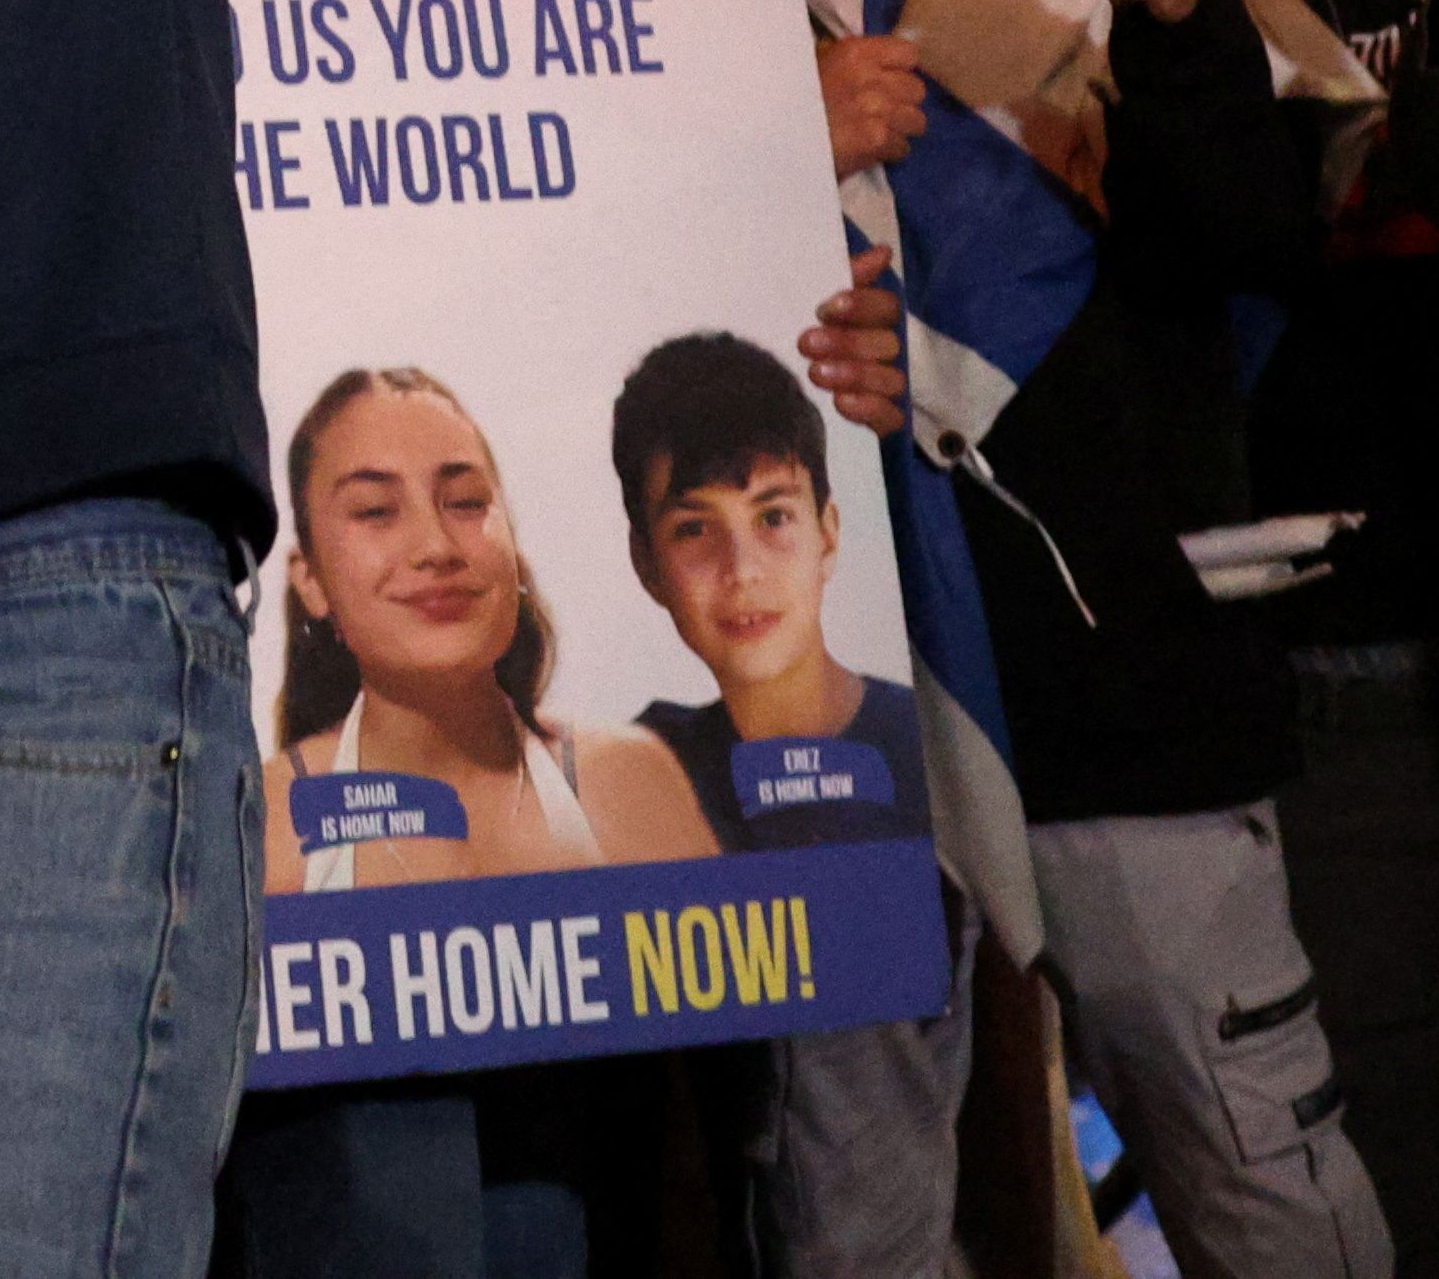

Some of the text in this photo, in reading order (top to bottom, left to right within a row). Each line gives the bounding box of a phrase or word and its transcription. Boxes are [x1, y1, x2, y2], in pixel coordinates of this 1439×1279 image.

[324, 110, 576, 206] WORLD
[343, 782, 398, 810] SAHAR
[757, 774, 854, 805] IS HOME NOW
[321, 809, 426, 841] IS HOME NOW
[389, 915, 610, 1041] HOME
[624, 896, 816, 1017] NOW!
